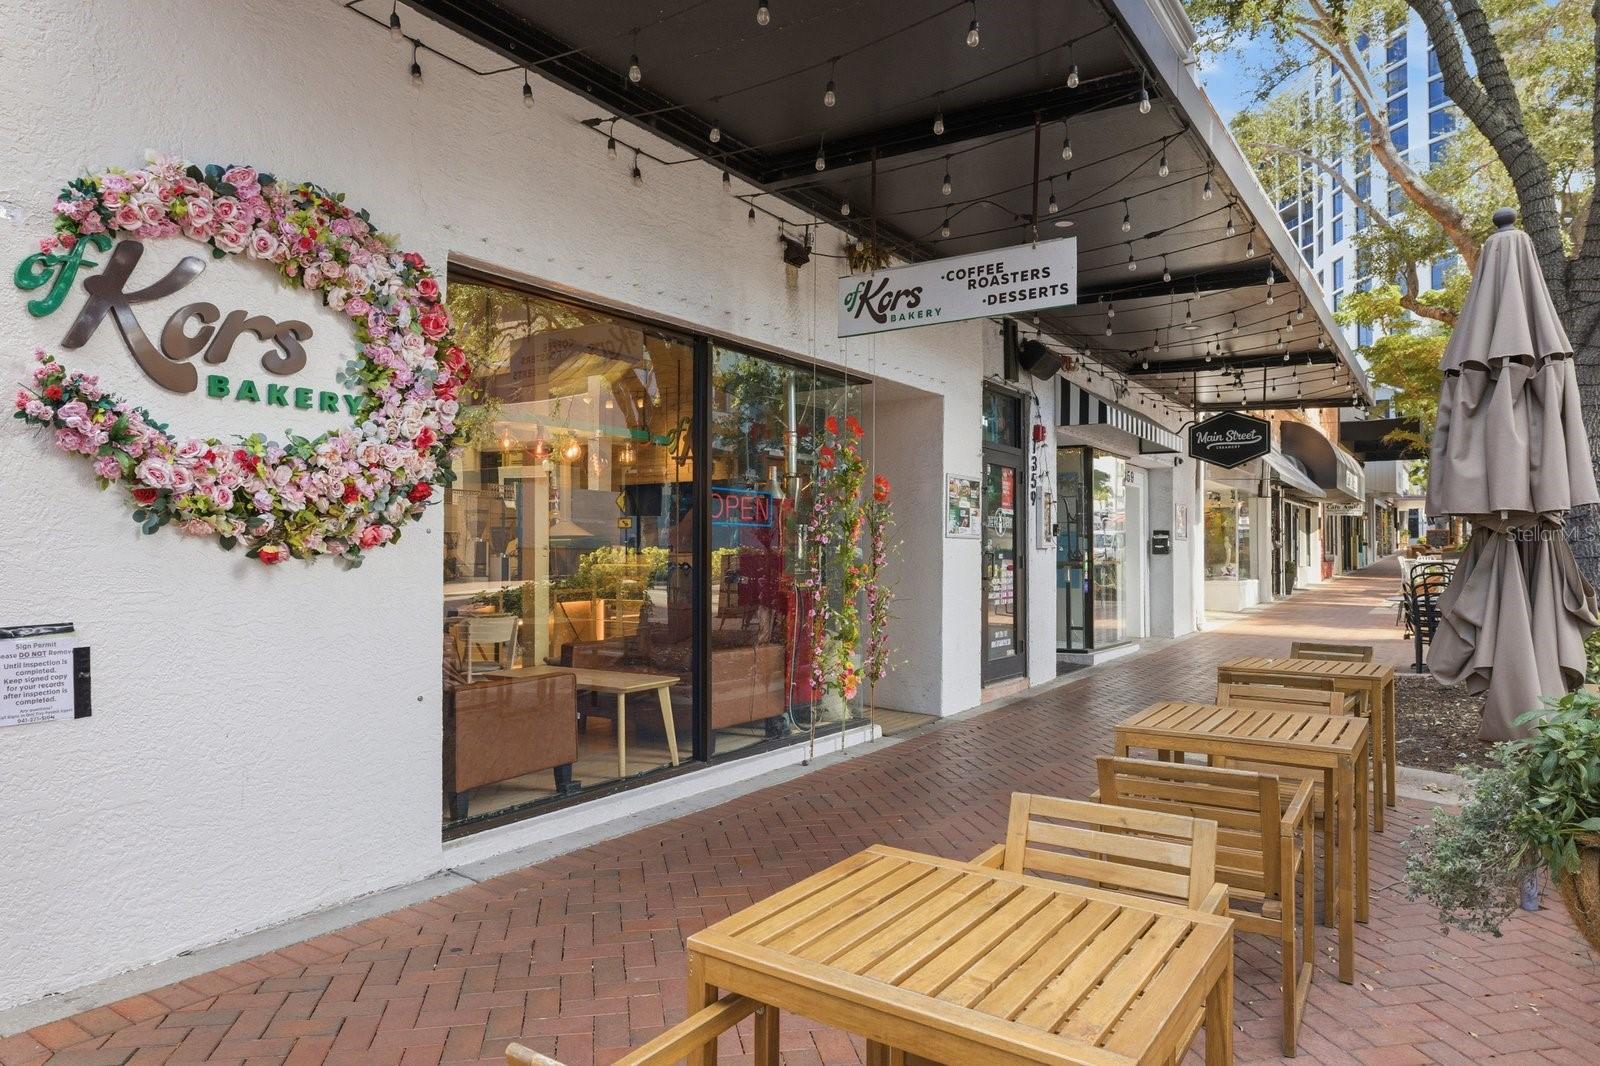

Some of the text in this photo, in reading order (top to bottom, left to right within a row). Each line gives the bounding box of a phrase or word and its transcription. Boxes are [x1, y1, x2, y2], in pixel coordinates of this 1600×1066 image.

[946, 262, 1004, 282] COFFEE
[967, 266, 1051, 290] ROASTERS
[987, 282, 1069, 306] DESSERTS
[890, 307, 942, 323] BAKERY
[207, 374, 365, 417] BAKERY
[1196, 429, 1262, 444] Main Street
[711, 493, 769, 521] OPEN
[15, 643, 32, 651] Sign
[3, 662, 22, 670] Until
[24, 675, 49, 683] signed
[38, 681, 65, 689] records
[3, 693, 22, 701] after
[23, 688, 61, 698] inspection
